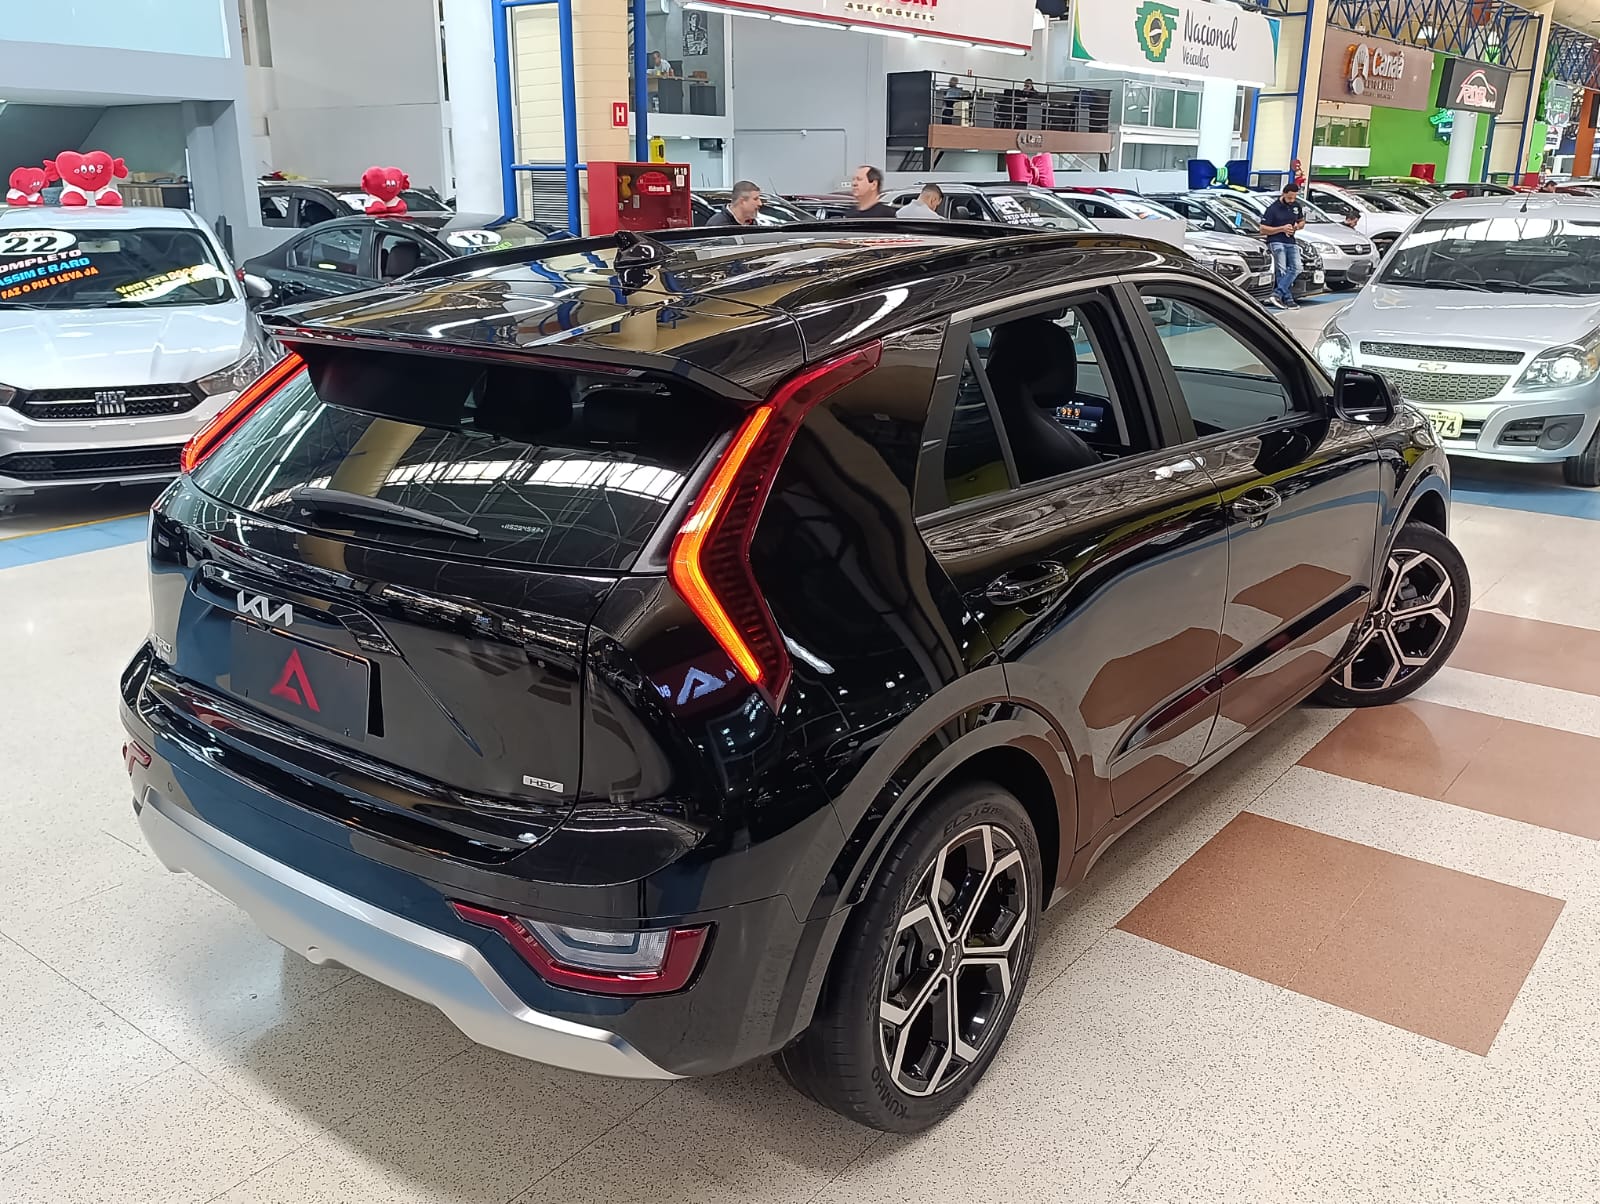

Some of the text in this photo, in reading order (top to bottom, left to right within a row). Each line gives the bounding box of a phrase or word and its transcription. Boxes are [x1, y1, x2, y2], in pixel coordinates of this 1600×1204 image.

[1184, 8, 1238, 51] Nacional
[616, 106, 625, 122] H
[2, 236, 58, 254] 22
[457, 233, 497, 247] 12
[37, 267, 47, 276] E
[48, 257, 91, 273] RARO
[1, 286, 22, 299] FAZ
[22, 284, 31, 293] O
[31, 278, 50, 290] PIX
[50, 276, 57, 286] E
[57, 269, 84, 284] LEVA
[115, 281, 147, 295] Vem
[95, 390, 126, 403] FIAT
[237, 590, 293, 627] KIA
[871, 1066, 908, 1119] KUMHO
